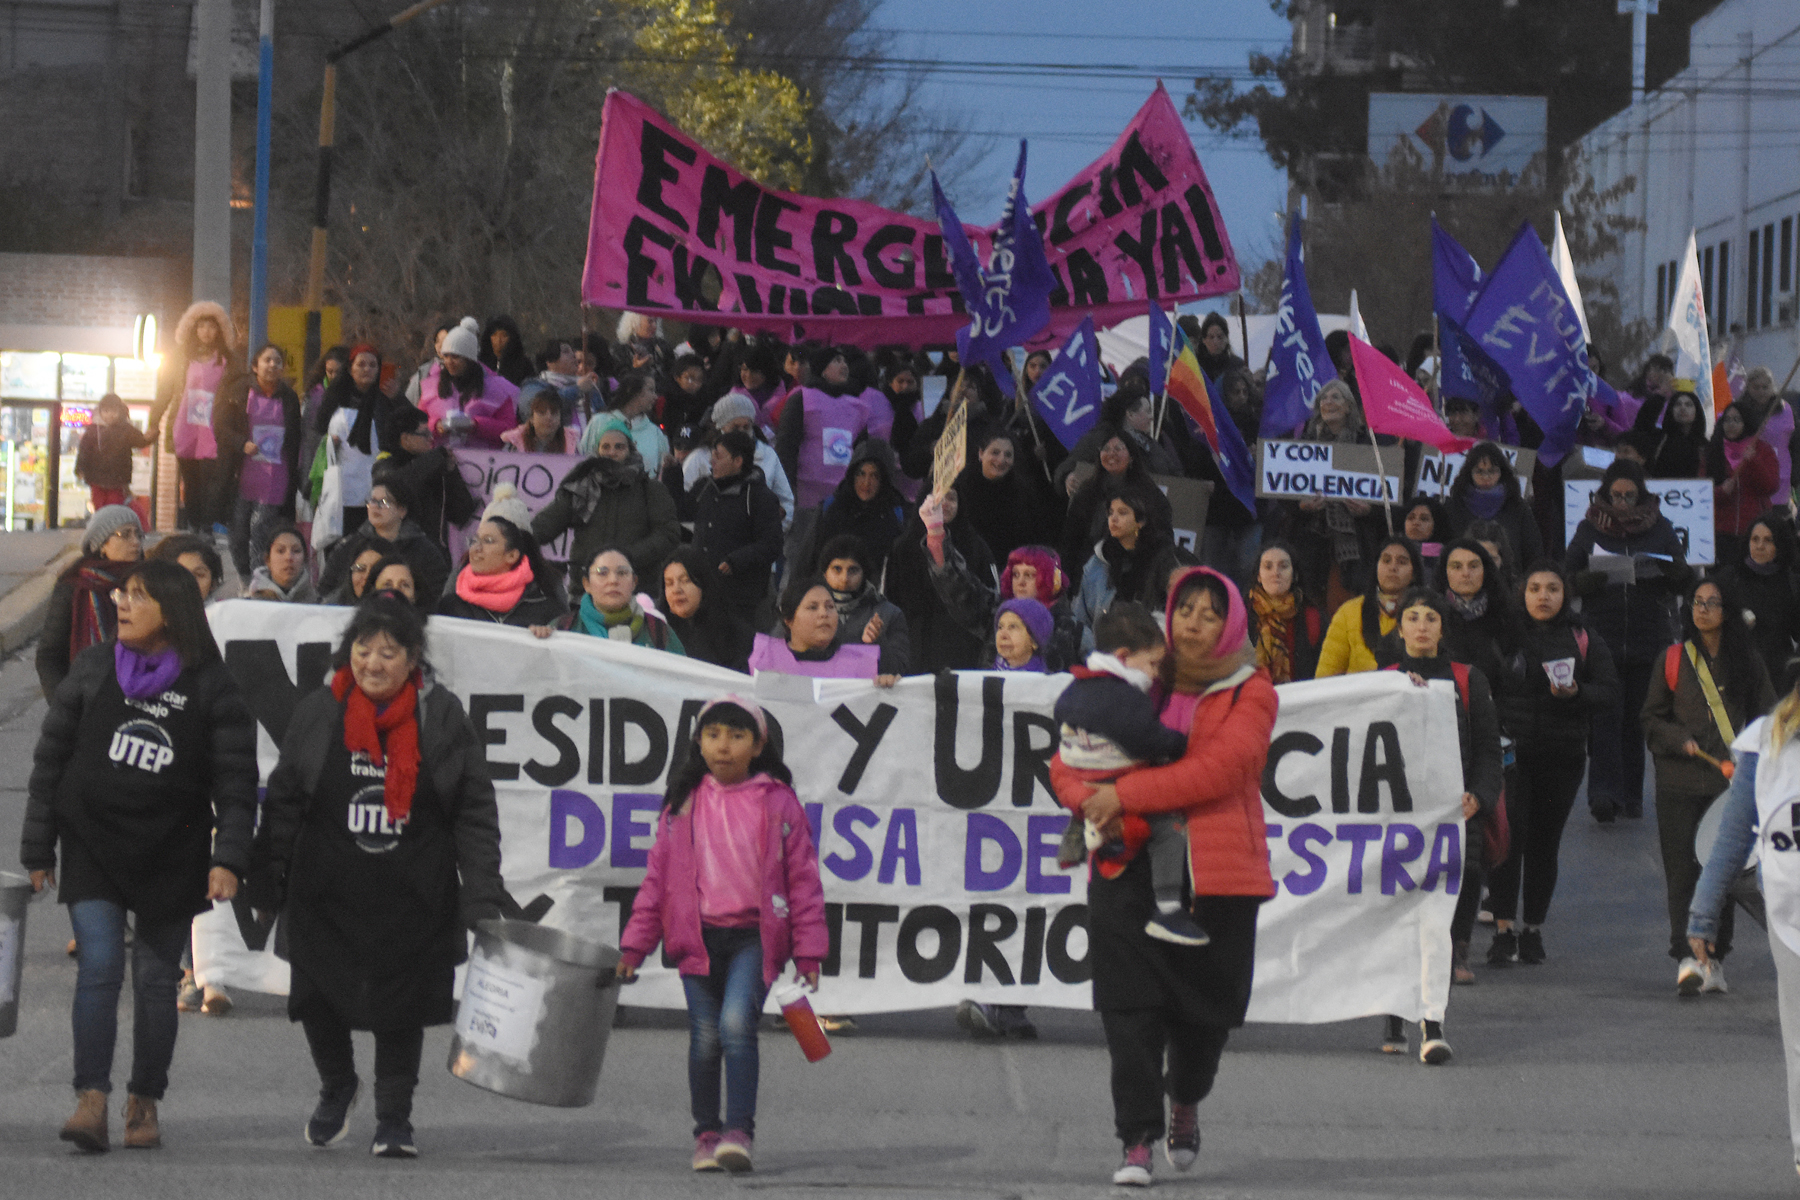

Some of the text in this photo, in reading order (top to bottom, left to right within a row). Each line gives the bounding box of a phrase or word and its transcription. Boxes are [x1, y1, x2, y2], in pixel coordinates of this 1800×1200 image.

[1113, 182, 1226, 300] YA!
[1268, 443, 1329, 462] Y CON
[1266, 471, 1394, 499] VIOLENCIA
[108, 731, 174, 774] UTEP
[830, 699, 898, 796] Y
[964, 812, 1072, 894] DE
